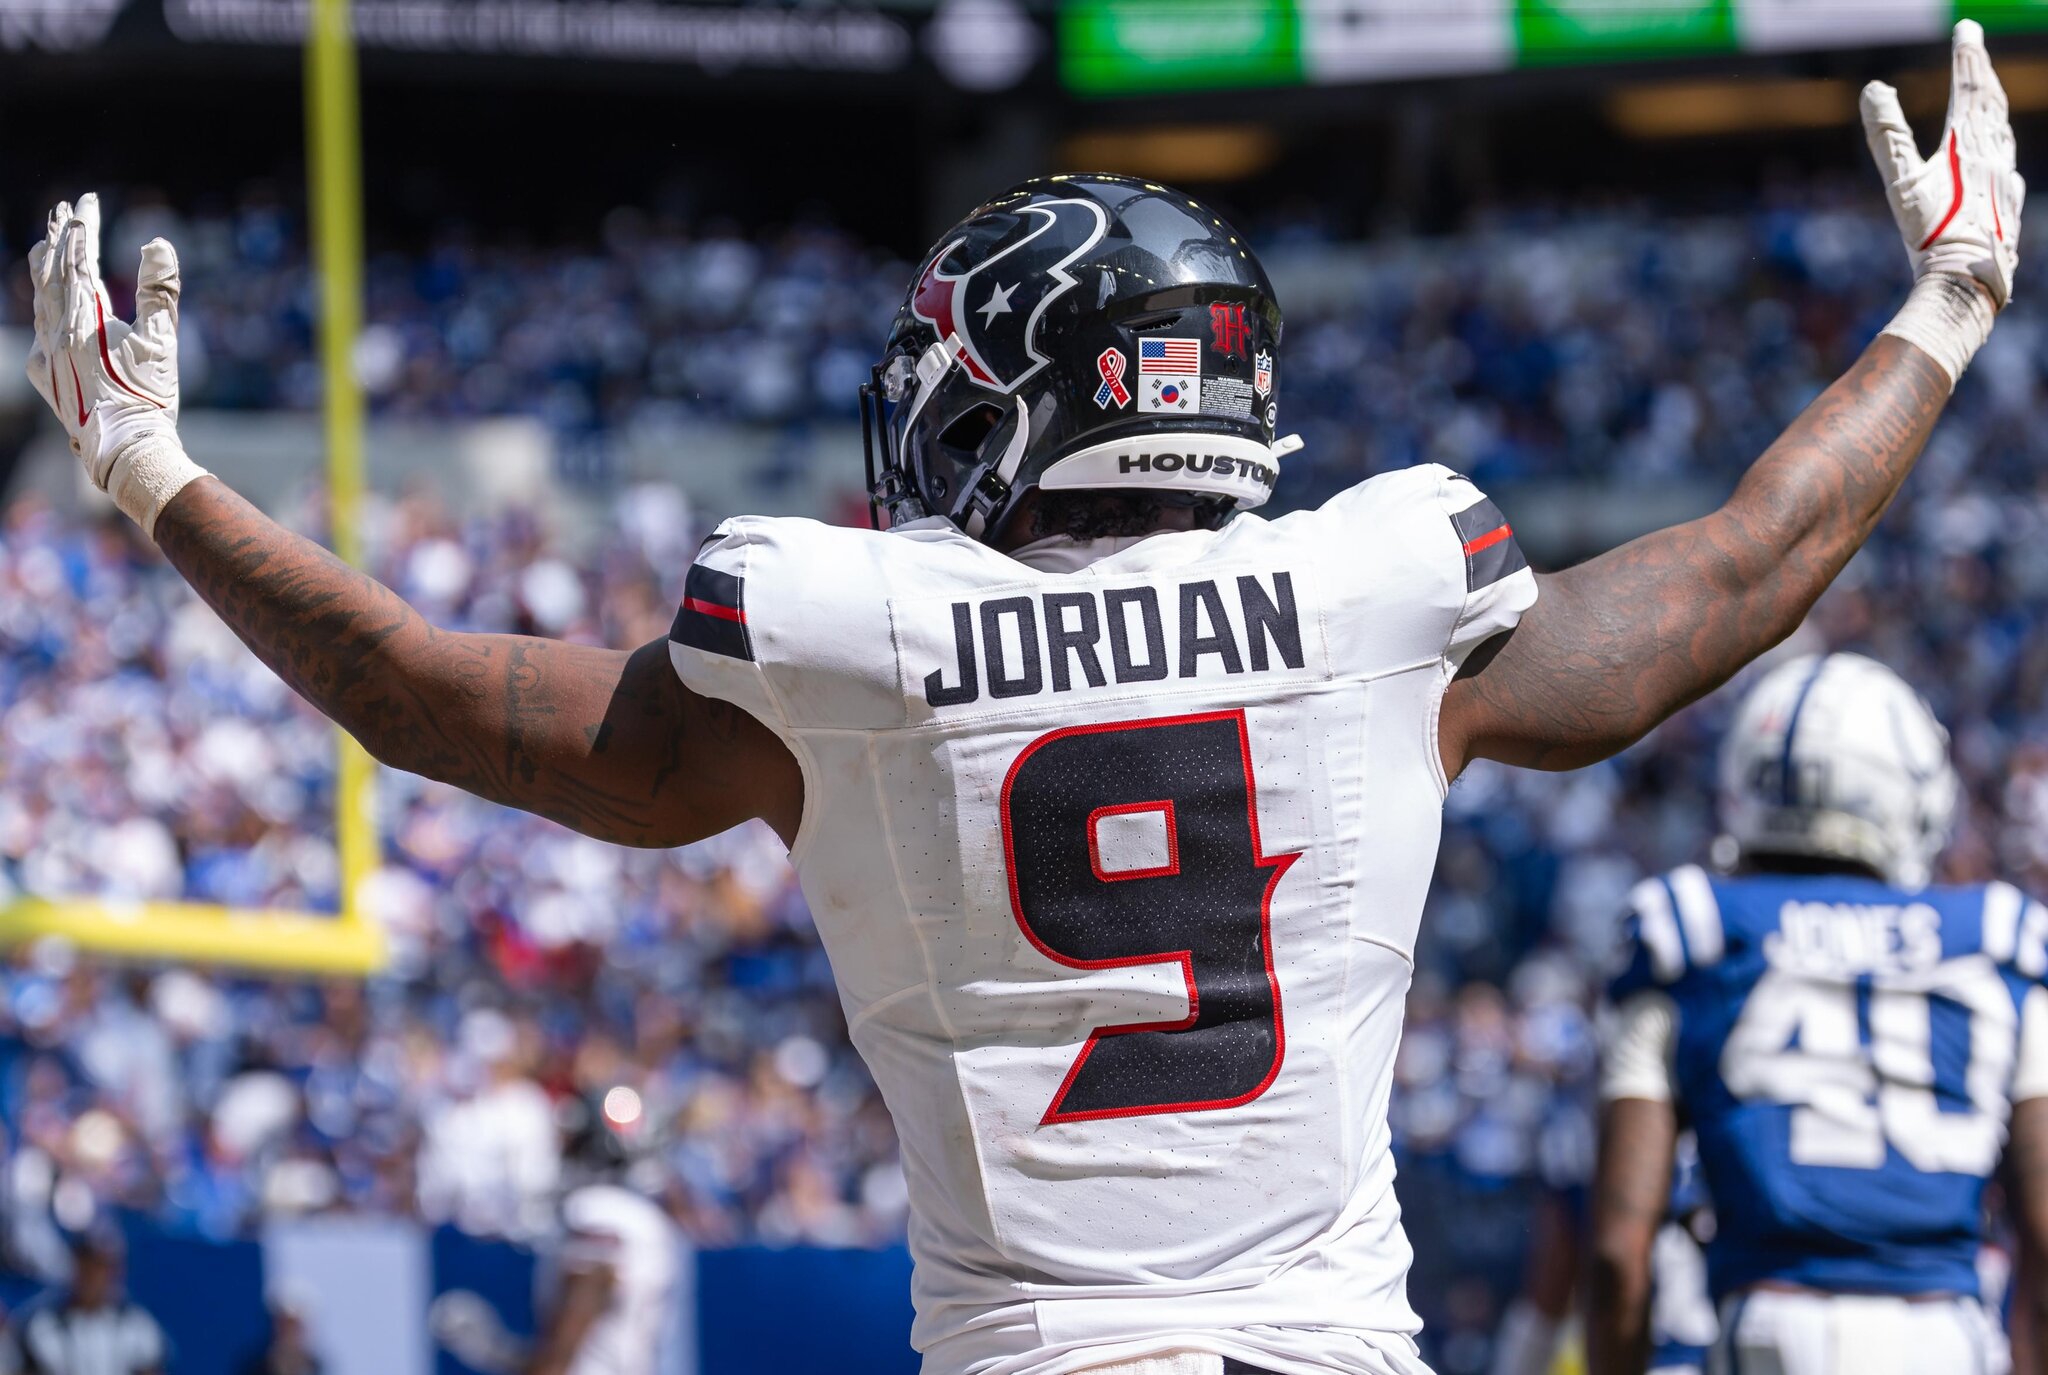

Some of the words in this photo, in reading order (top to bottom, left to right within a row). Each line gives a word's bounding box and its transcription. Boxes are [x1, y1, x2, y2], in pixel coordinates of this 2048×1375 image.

[1105, 370, 1119, 389] 9/11
[1257, 371, 1269, 391] NFL
[924, 571, 1305, 707] JORDAN
[1001, 708, 1303, 1125] 9
[1764, 900, 1942, 974] JONES
[1718, 953, 2016, 1174] 40
